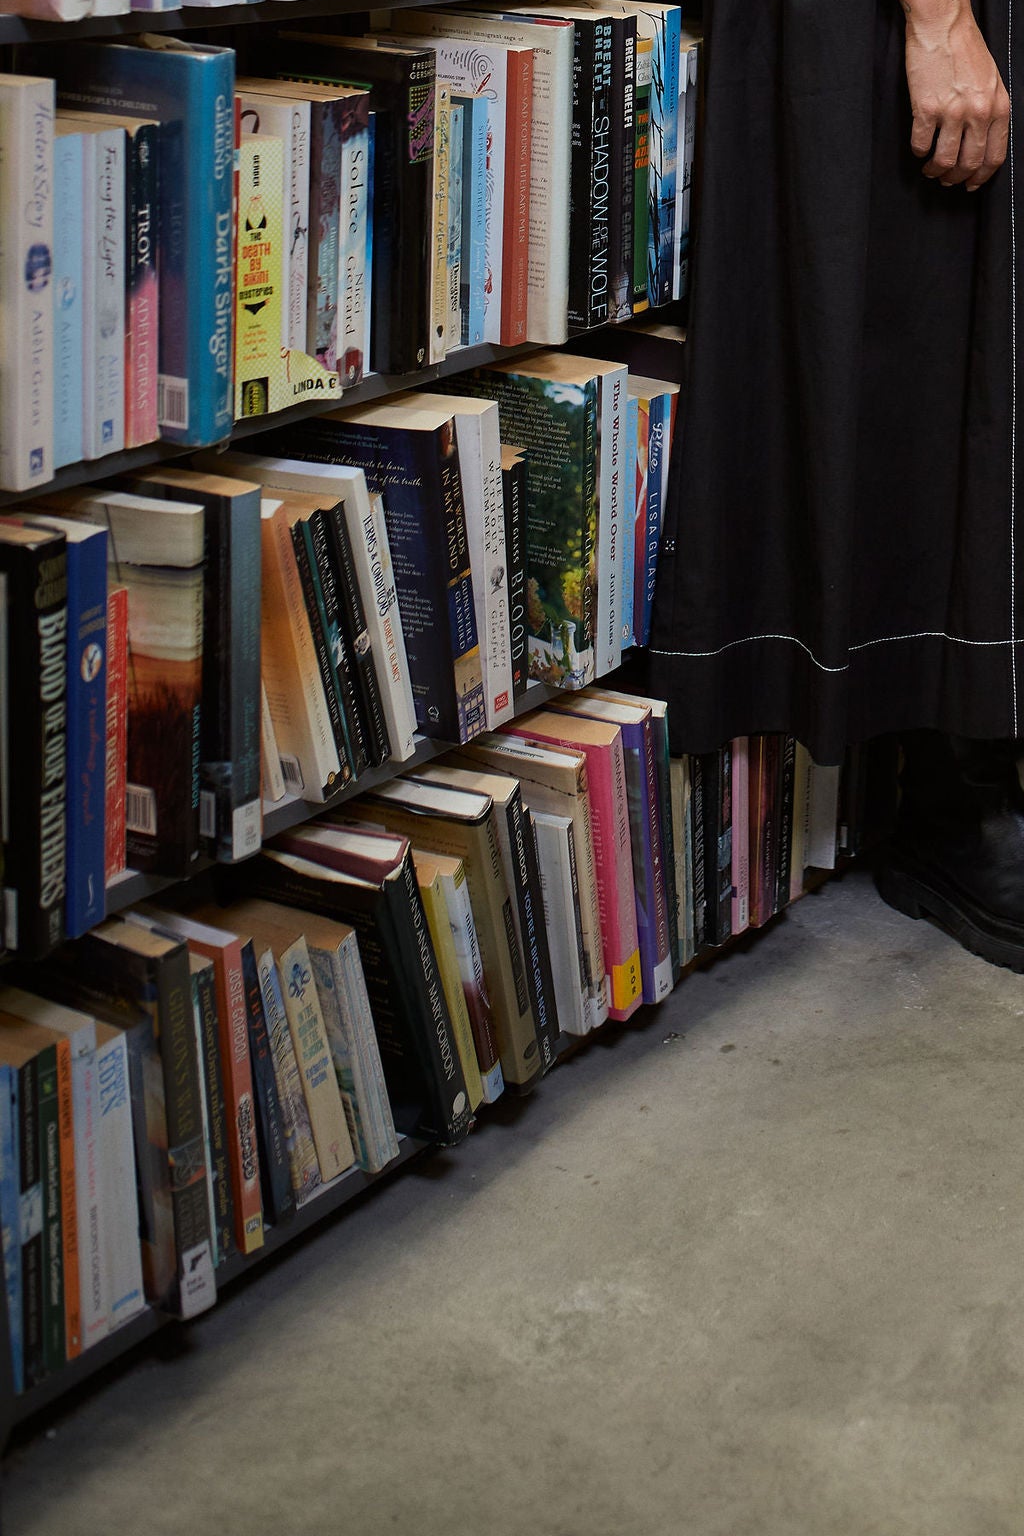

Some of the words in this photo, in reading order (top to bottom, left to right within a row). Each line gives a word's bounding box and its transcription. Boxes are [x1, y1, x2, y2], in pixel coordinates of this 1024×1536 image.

[593, 24, 603, 92] GHELFI
[603, 24, 612, 86] BRENT
[213, 95, 227, 180] GEREND
[252, 154, 260, 187] GERBER
[347, 150, 364, 234] Solace
[593, 116, 610, 222] SHADOW
[213, 212, 231, 291] Dark
[599, 226, 608, 240] OF
[344, 256, 356, 335] Gerrard
[355, 272, 364, 314] Nicci
[591, 252, 607, 318] WOLF
[209, 295, 231, 378] Singer
[611, 380, 620, 411] The
[611, 415, 620, 466] Whole
[442, 468, 450, 486] IN
[610, 470, 620, 520] World
[444, 492, 453, 512] MY
[511, 479, 519, 524] JOSEPH
[447, 522, 458, 569] HAND
[512, 527, 520, 564] GLASS
[609, 524, 618, 562] Over
[363, 514, 377, 553] TERMS
[383, 618, 394, 651] ROBERT
[390, 654, 400, 683] GLANCY
[608, 573, 616, 606] Julia
[510, 568, 523, 661] BLOOD
[608, 610, 616, 646] Glass
[39, 609, 68, 703] BLOOD
[43, 705, 66, 738] OF
[42, 740, 66, 788] OUR
[511, 802, 521, 824] NEIL
[39, 790, 65, 910] FATHERS
[516, 830, 528, 886] GORDON
[524, 890, 536, 937] YOU'RE
[528, 937, 536, 945] A
[530, 946, 539, 964] BIG
[409, 896, 422, 928] AND
[417, 930, 434, 981] ANGELS
[429, 983, 442, 1023] MARY
[436, 1023, 455, 1081] GORDON
[532, 965, 542, 994] GIRL
[536, 996, 547, 1027] NOW
